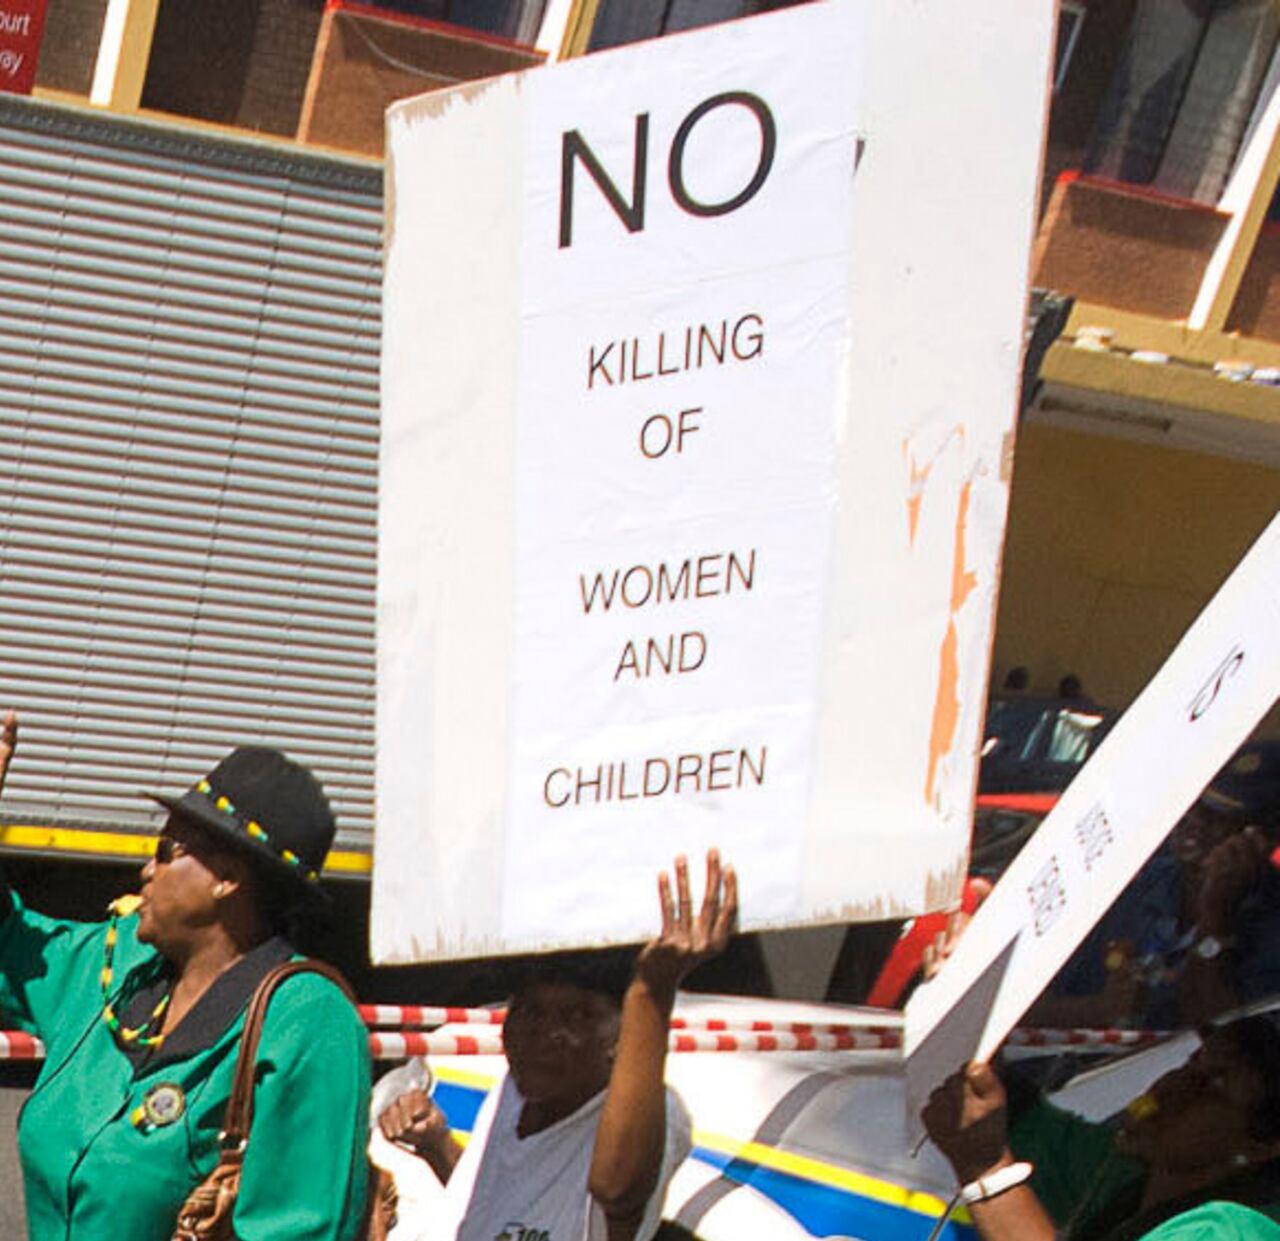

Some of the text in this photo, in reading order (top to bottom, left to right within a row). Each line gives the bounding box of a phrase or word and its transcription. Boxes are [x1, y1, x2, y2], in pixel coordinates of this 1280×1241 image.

[558, 90, 778, 250] NO
[587, 313, 765, 389] KILLING
[639, 407, 703, 460] OF
[581, 549, 756, 615] WOMEN
[614, 631, 707, 682] AND
[543, 748, 766, 809] CHILDREN
